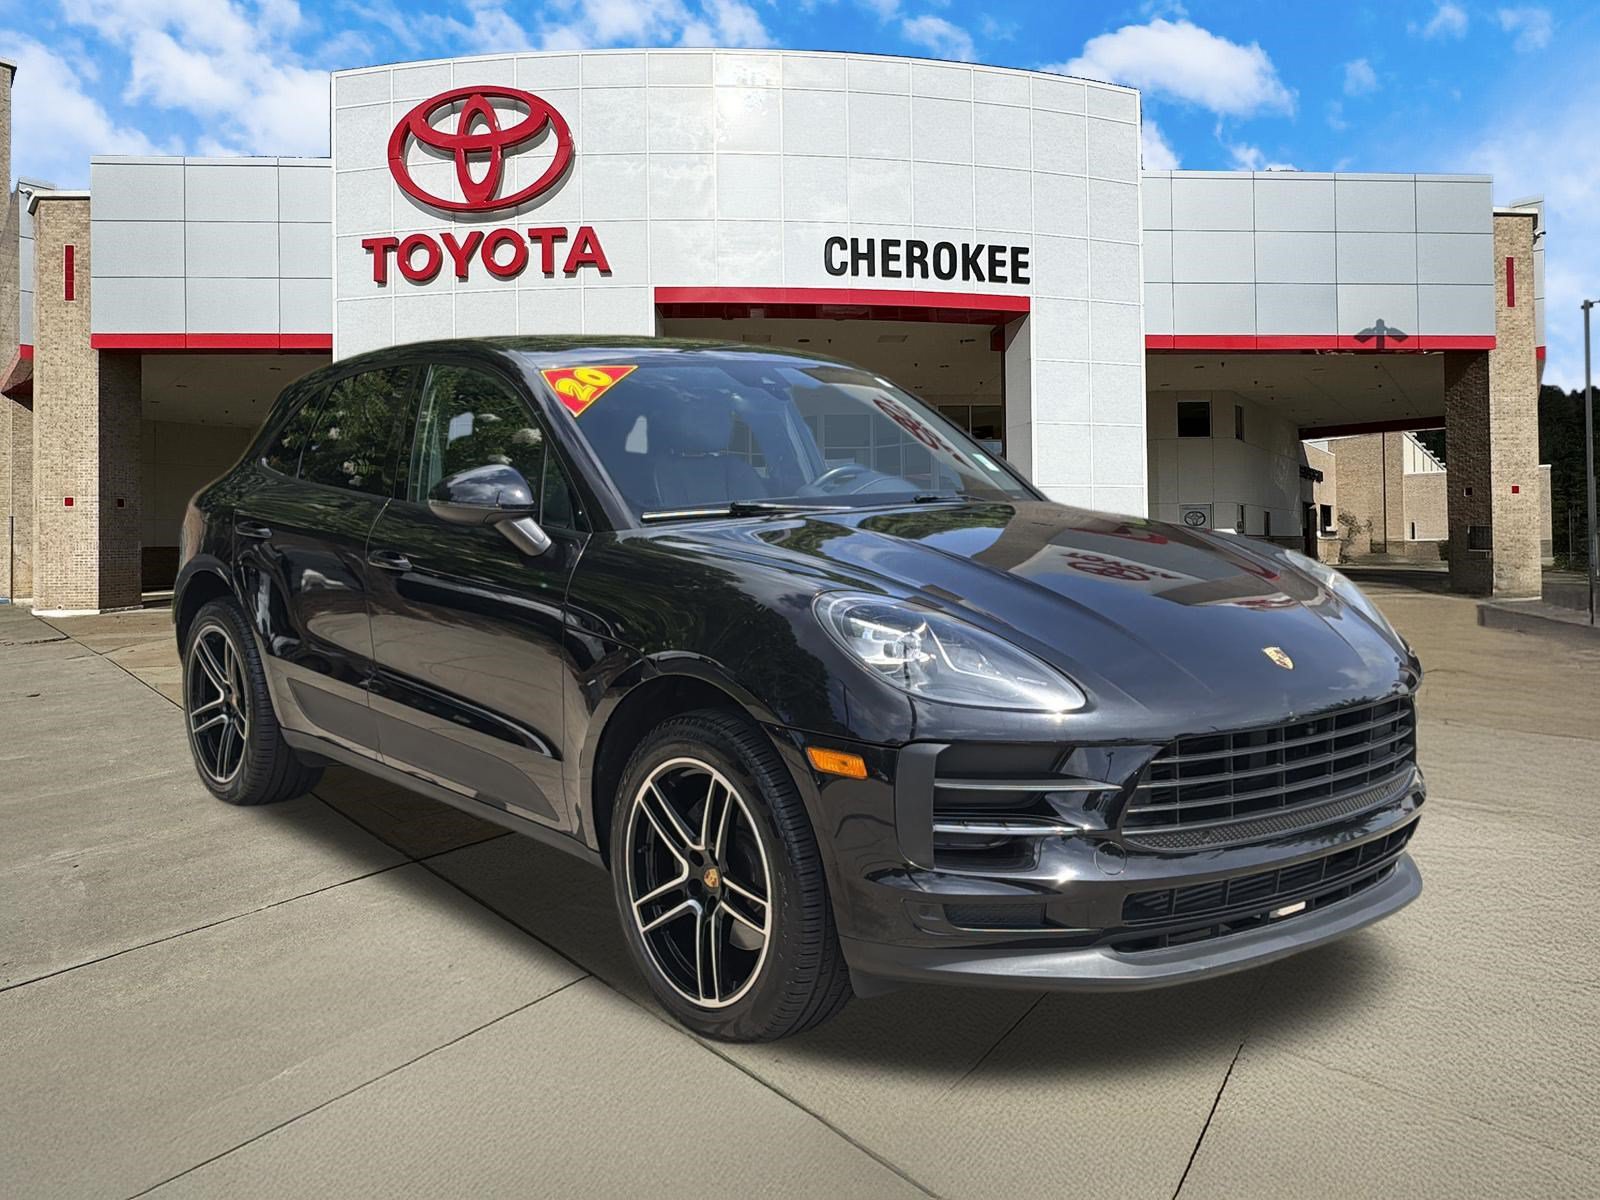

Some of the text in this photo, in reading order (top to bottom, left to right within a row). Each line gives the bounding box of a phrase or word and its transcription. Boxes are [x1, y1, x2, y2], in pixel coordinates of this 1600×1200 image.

[362, 226, 612, 283] TOYOTA
[824, 236, 1030, 284] CHEROKEE
[555, 367, 612, 402] 20
